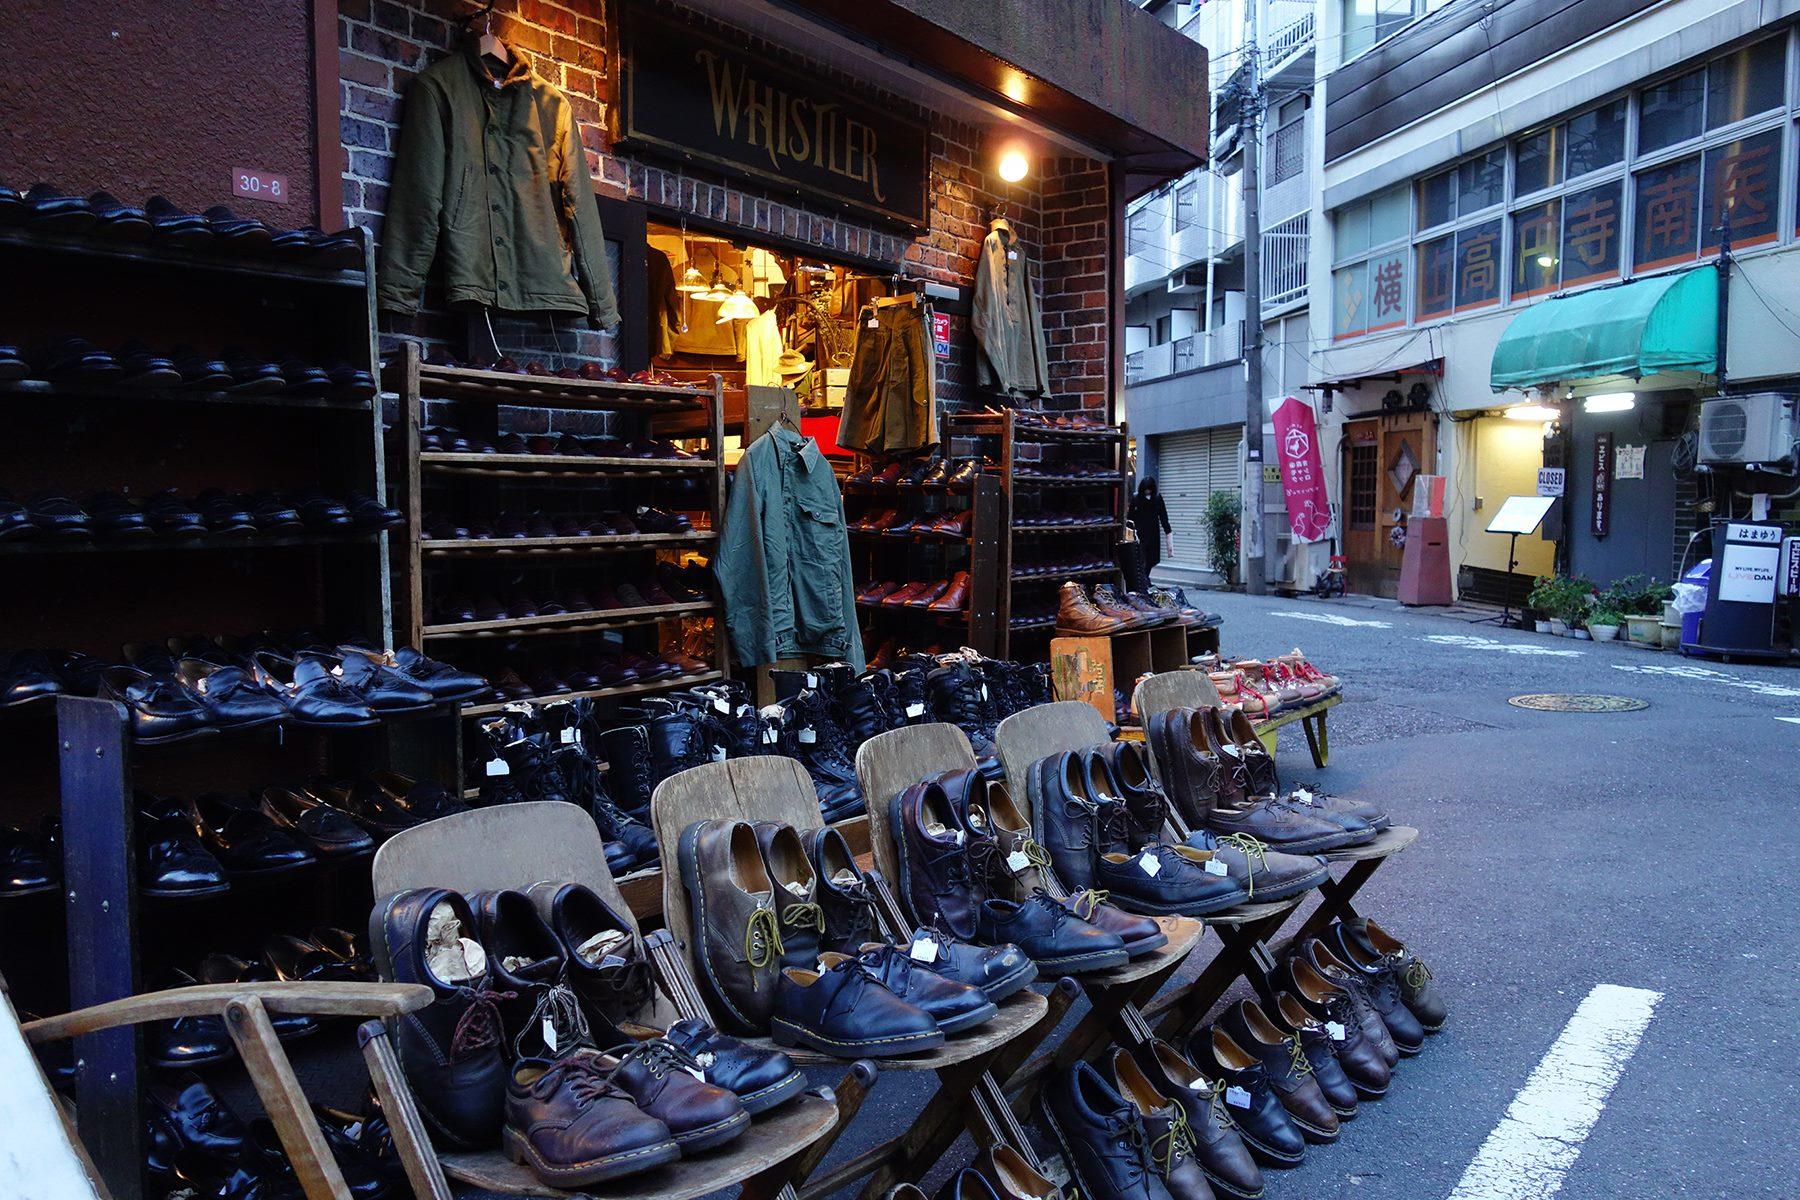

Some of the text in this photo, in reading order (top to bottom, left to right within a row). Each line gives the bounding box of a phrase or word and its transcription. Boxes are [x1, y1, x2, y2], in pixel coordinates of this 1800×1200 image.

[695, 49, 886, 203] WHISTLER
[240, 175, 281, 196] 30-8
[1538, 471, 1563, 485] CLOSED
[1739, 528, 1776, 540] はまゆう
